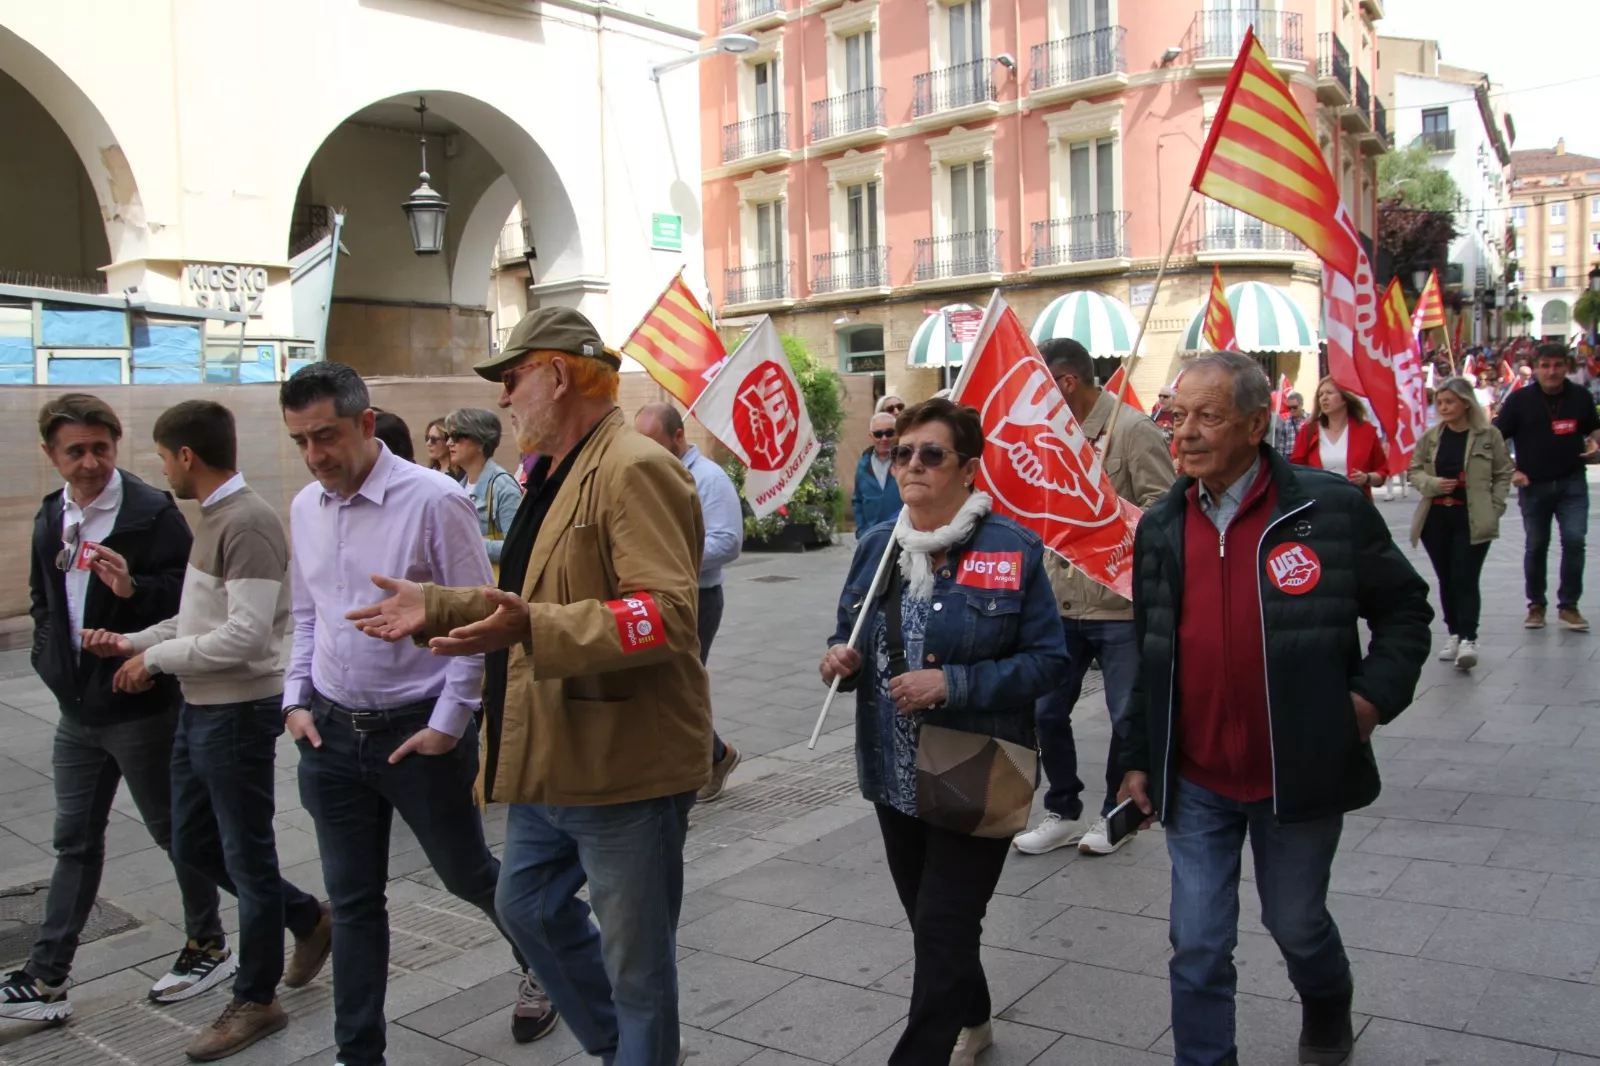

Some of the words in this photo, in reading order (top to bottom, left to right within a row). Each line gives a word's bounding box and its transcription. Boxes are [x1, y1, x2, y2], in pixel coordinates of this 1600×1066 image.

[187, 264, 268, 292] KIOSKO
[196, 292, 264, 319] SANZ
[757, 367, 797, 446] UGT
[755, 439, 814, 506] www.UGT.es
[963, 559, 996, 575] UGT
[1269, 546, 1309, 580] UGT
[994, 575, 1016, 583] Aragón
[626, 621, 638, 646] Aragón
